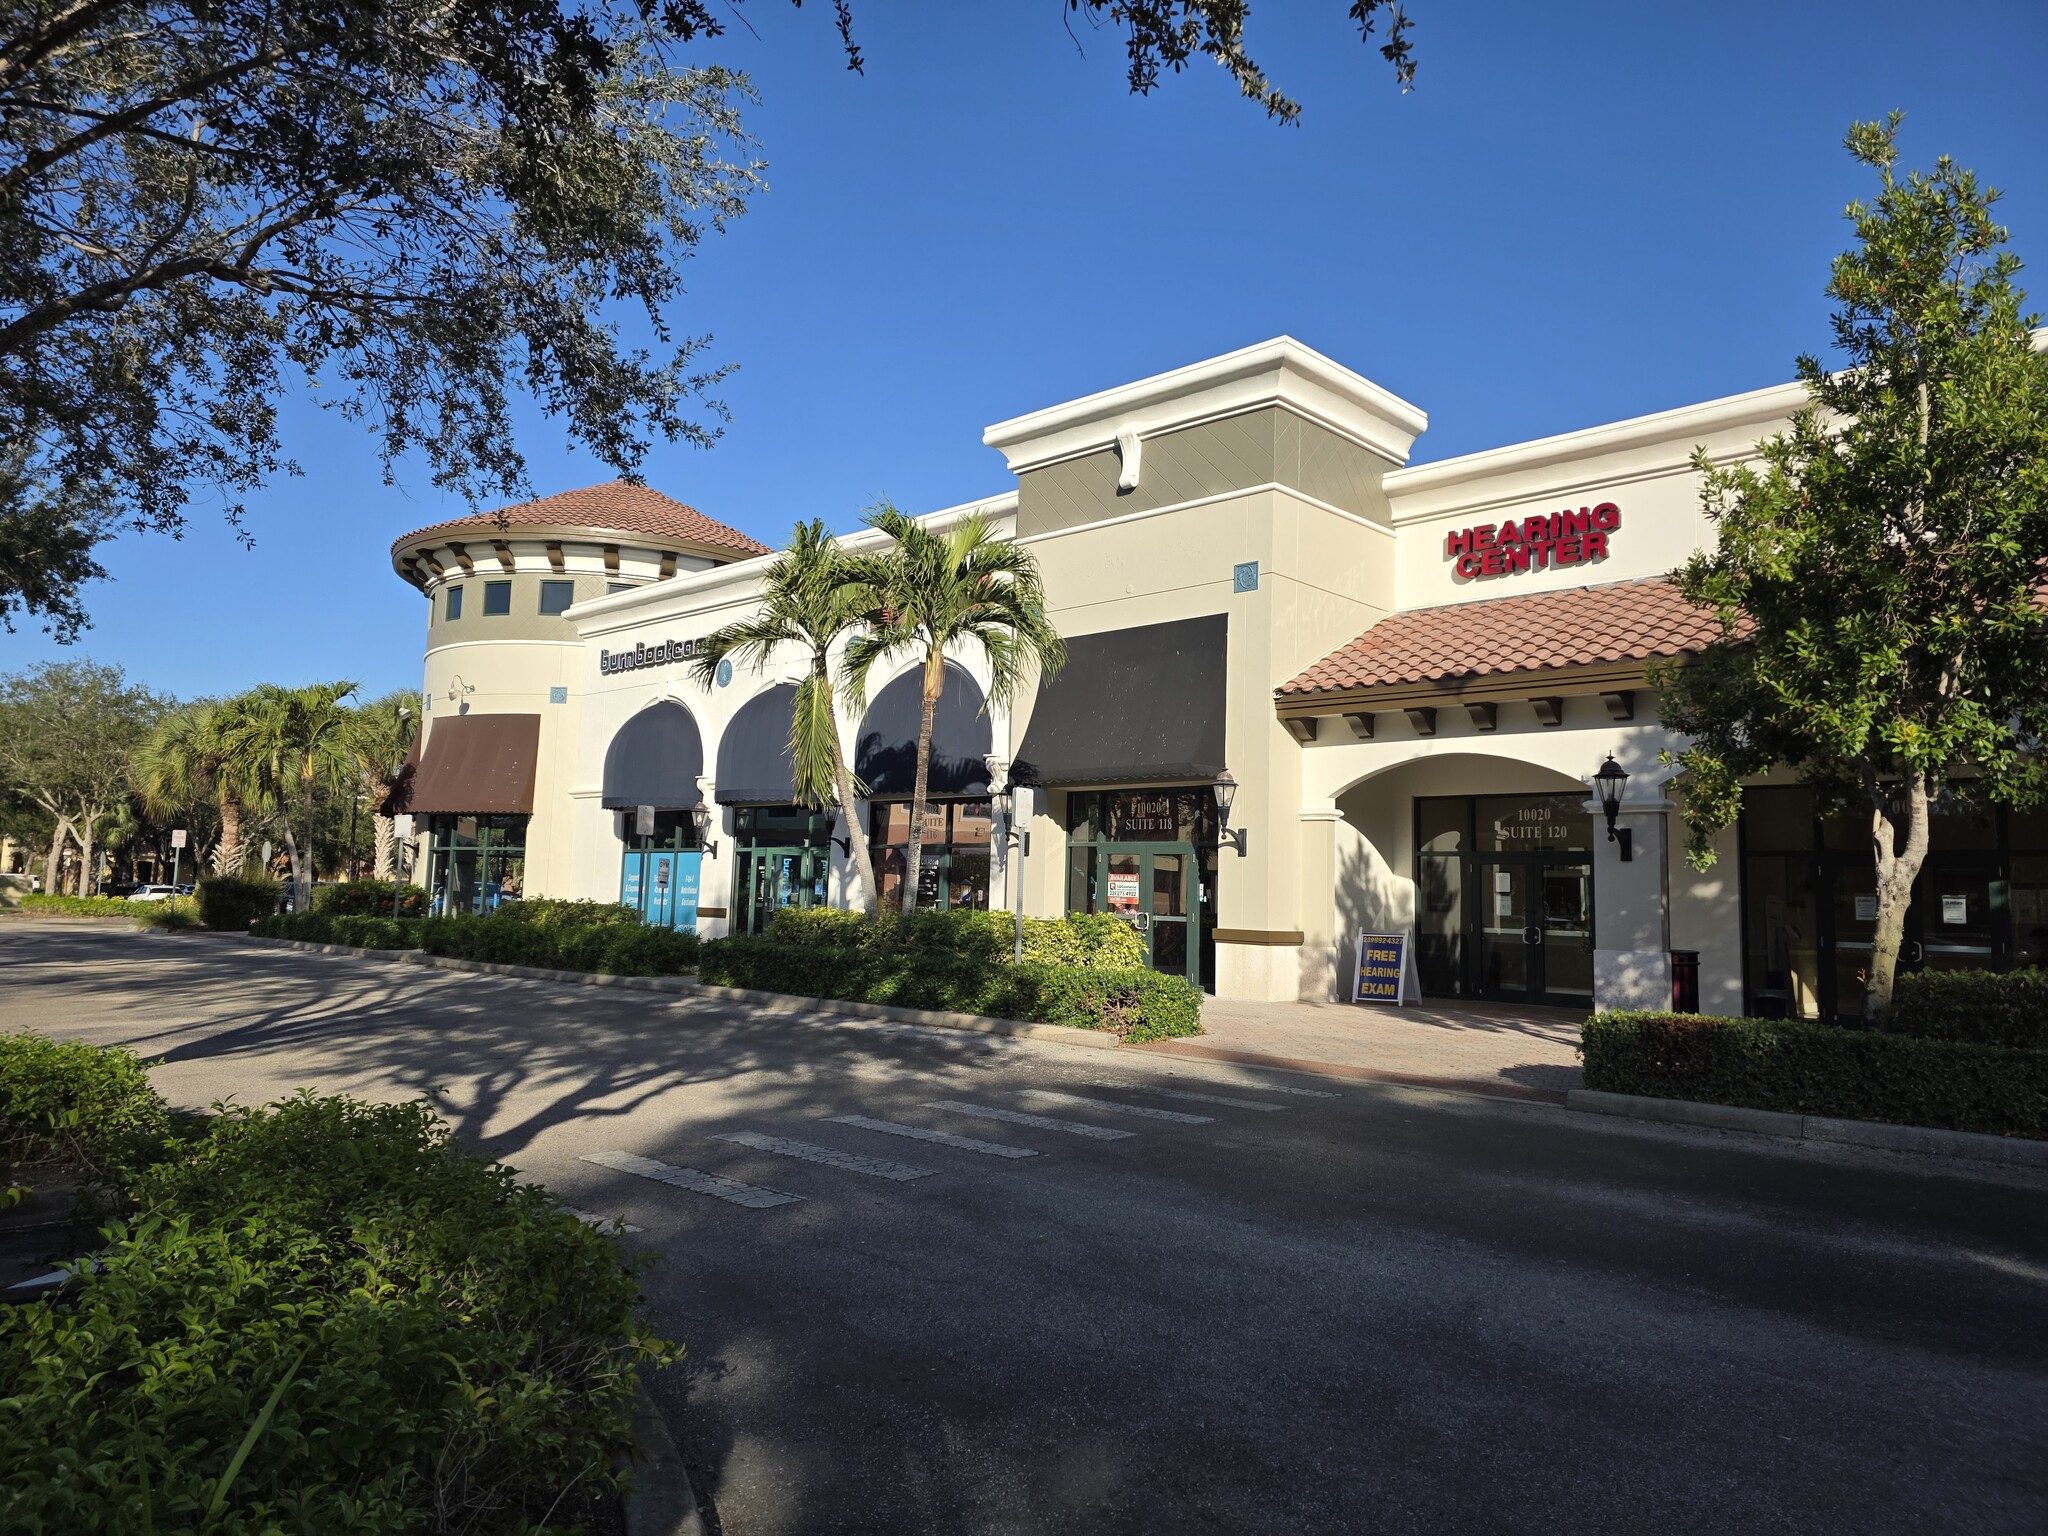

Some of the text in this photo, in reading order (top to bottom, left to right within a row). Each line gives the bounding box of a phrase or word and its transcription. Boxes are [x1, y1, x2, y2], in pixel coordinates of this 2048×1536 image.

[1447, 502, 1622, 557] HEARING
[1456, 531, 1609, 579] CENTER
[1137, 801, 1161, 814] 10020
[1518, 808, 1551, 821] 10020
[920, 818, 944, 827] UITE
[1125, 817, 1173, 830] SUITE 118
[1503, 825, 1568, 839] SUITE 120
[1366, 950, 1397, 962] FREE
[1360, 966, 1401, 978] HEARING
[1361, 983, 1396, 996] EXAM
